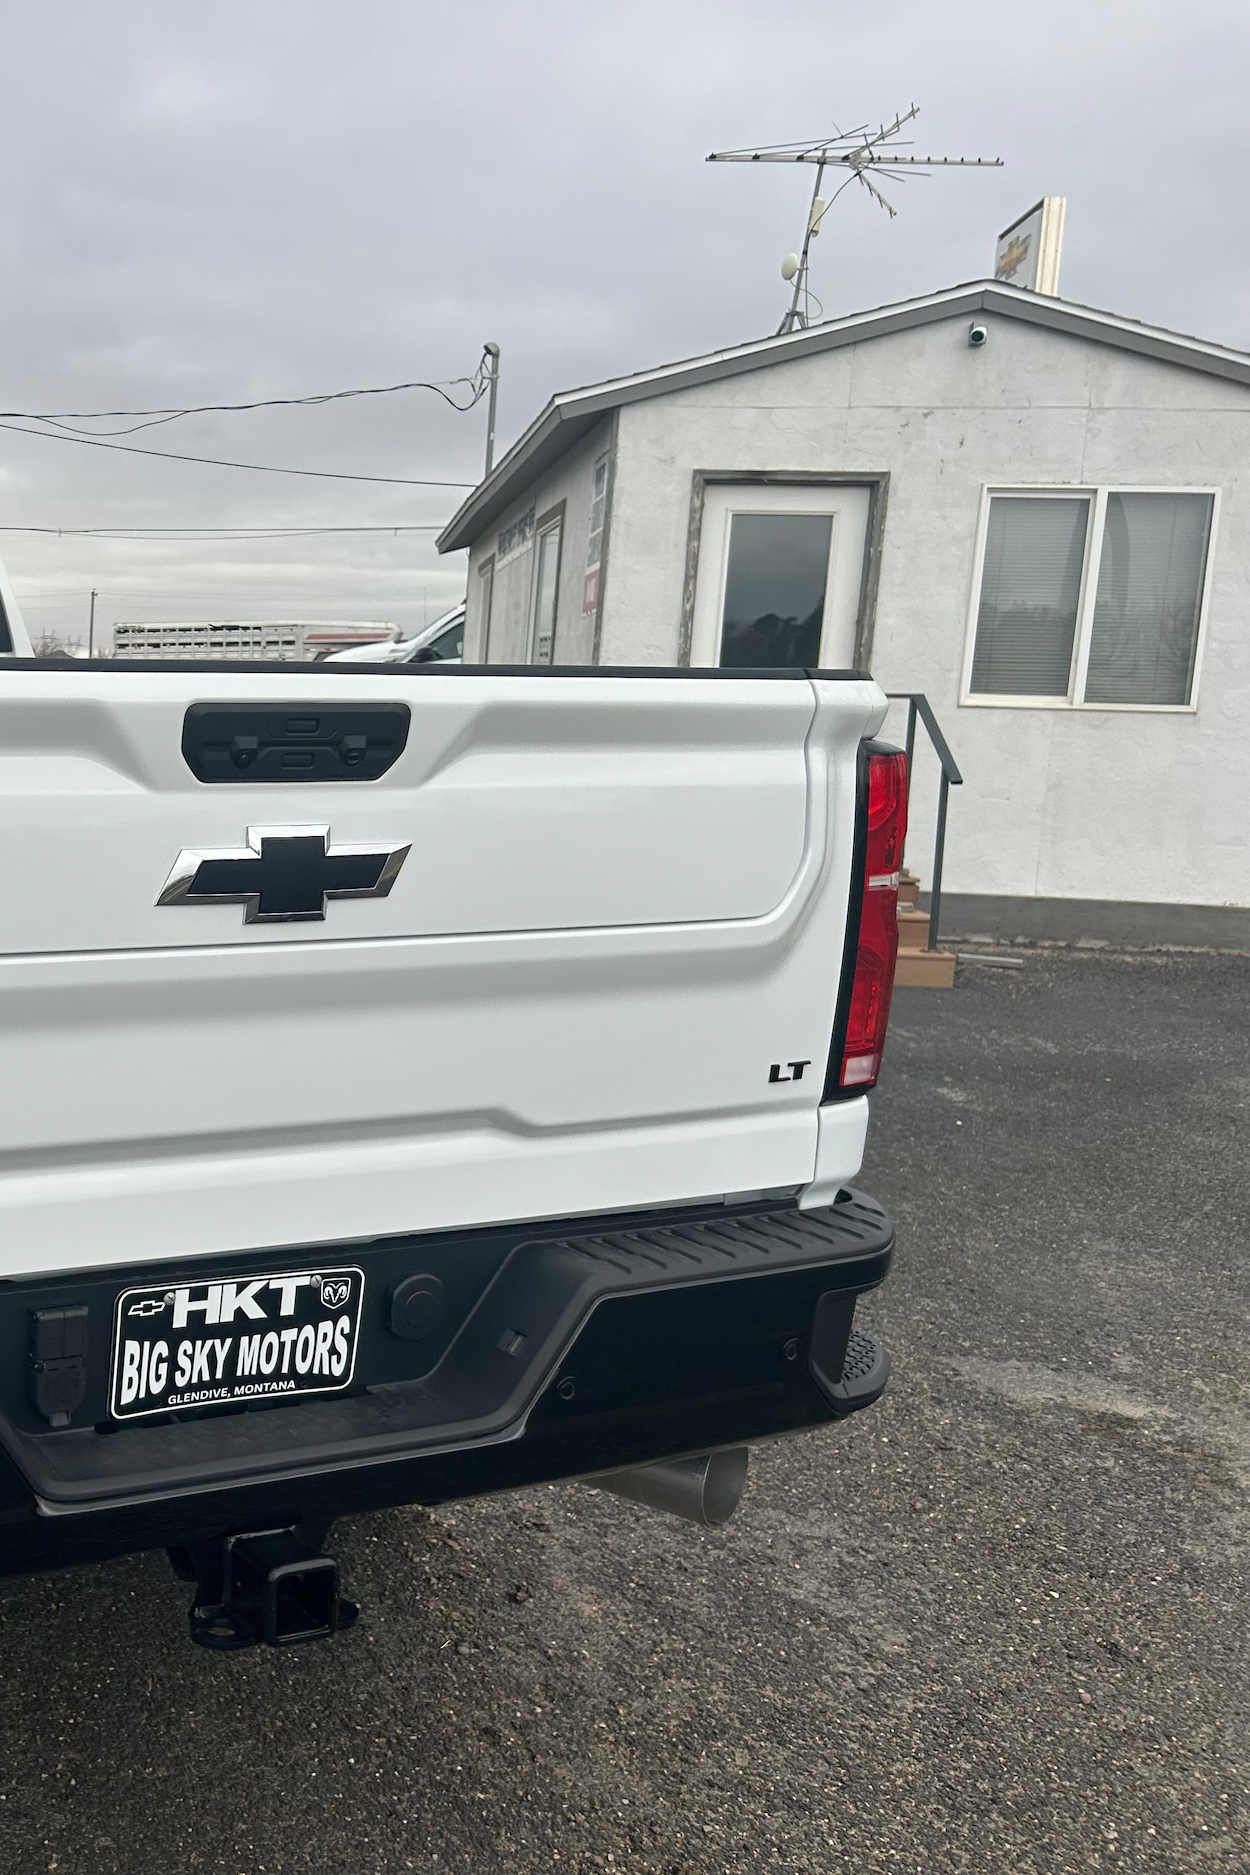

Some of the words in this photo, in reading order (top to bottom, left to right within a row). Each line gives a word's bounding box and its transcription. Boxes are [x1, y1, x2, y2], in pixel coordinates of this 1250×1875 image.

[768, 1060, 812, 1083] LT
[172, 1275, 312, 1329] HKT
[120, 1339, 169, 1406] BIG
[174, 1337, 233, 1388] SKY
[235, 1314, 351, 1377] MOTORS
[167, 1387, 232, 1405] GLENDIVE,
[233, 1379, 296, 1396] MONTANA
